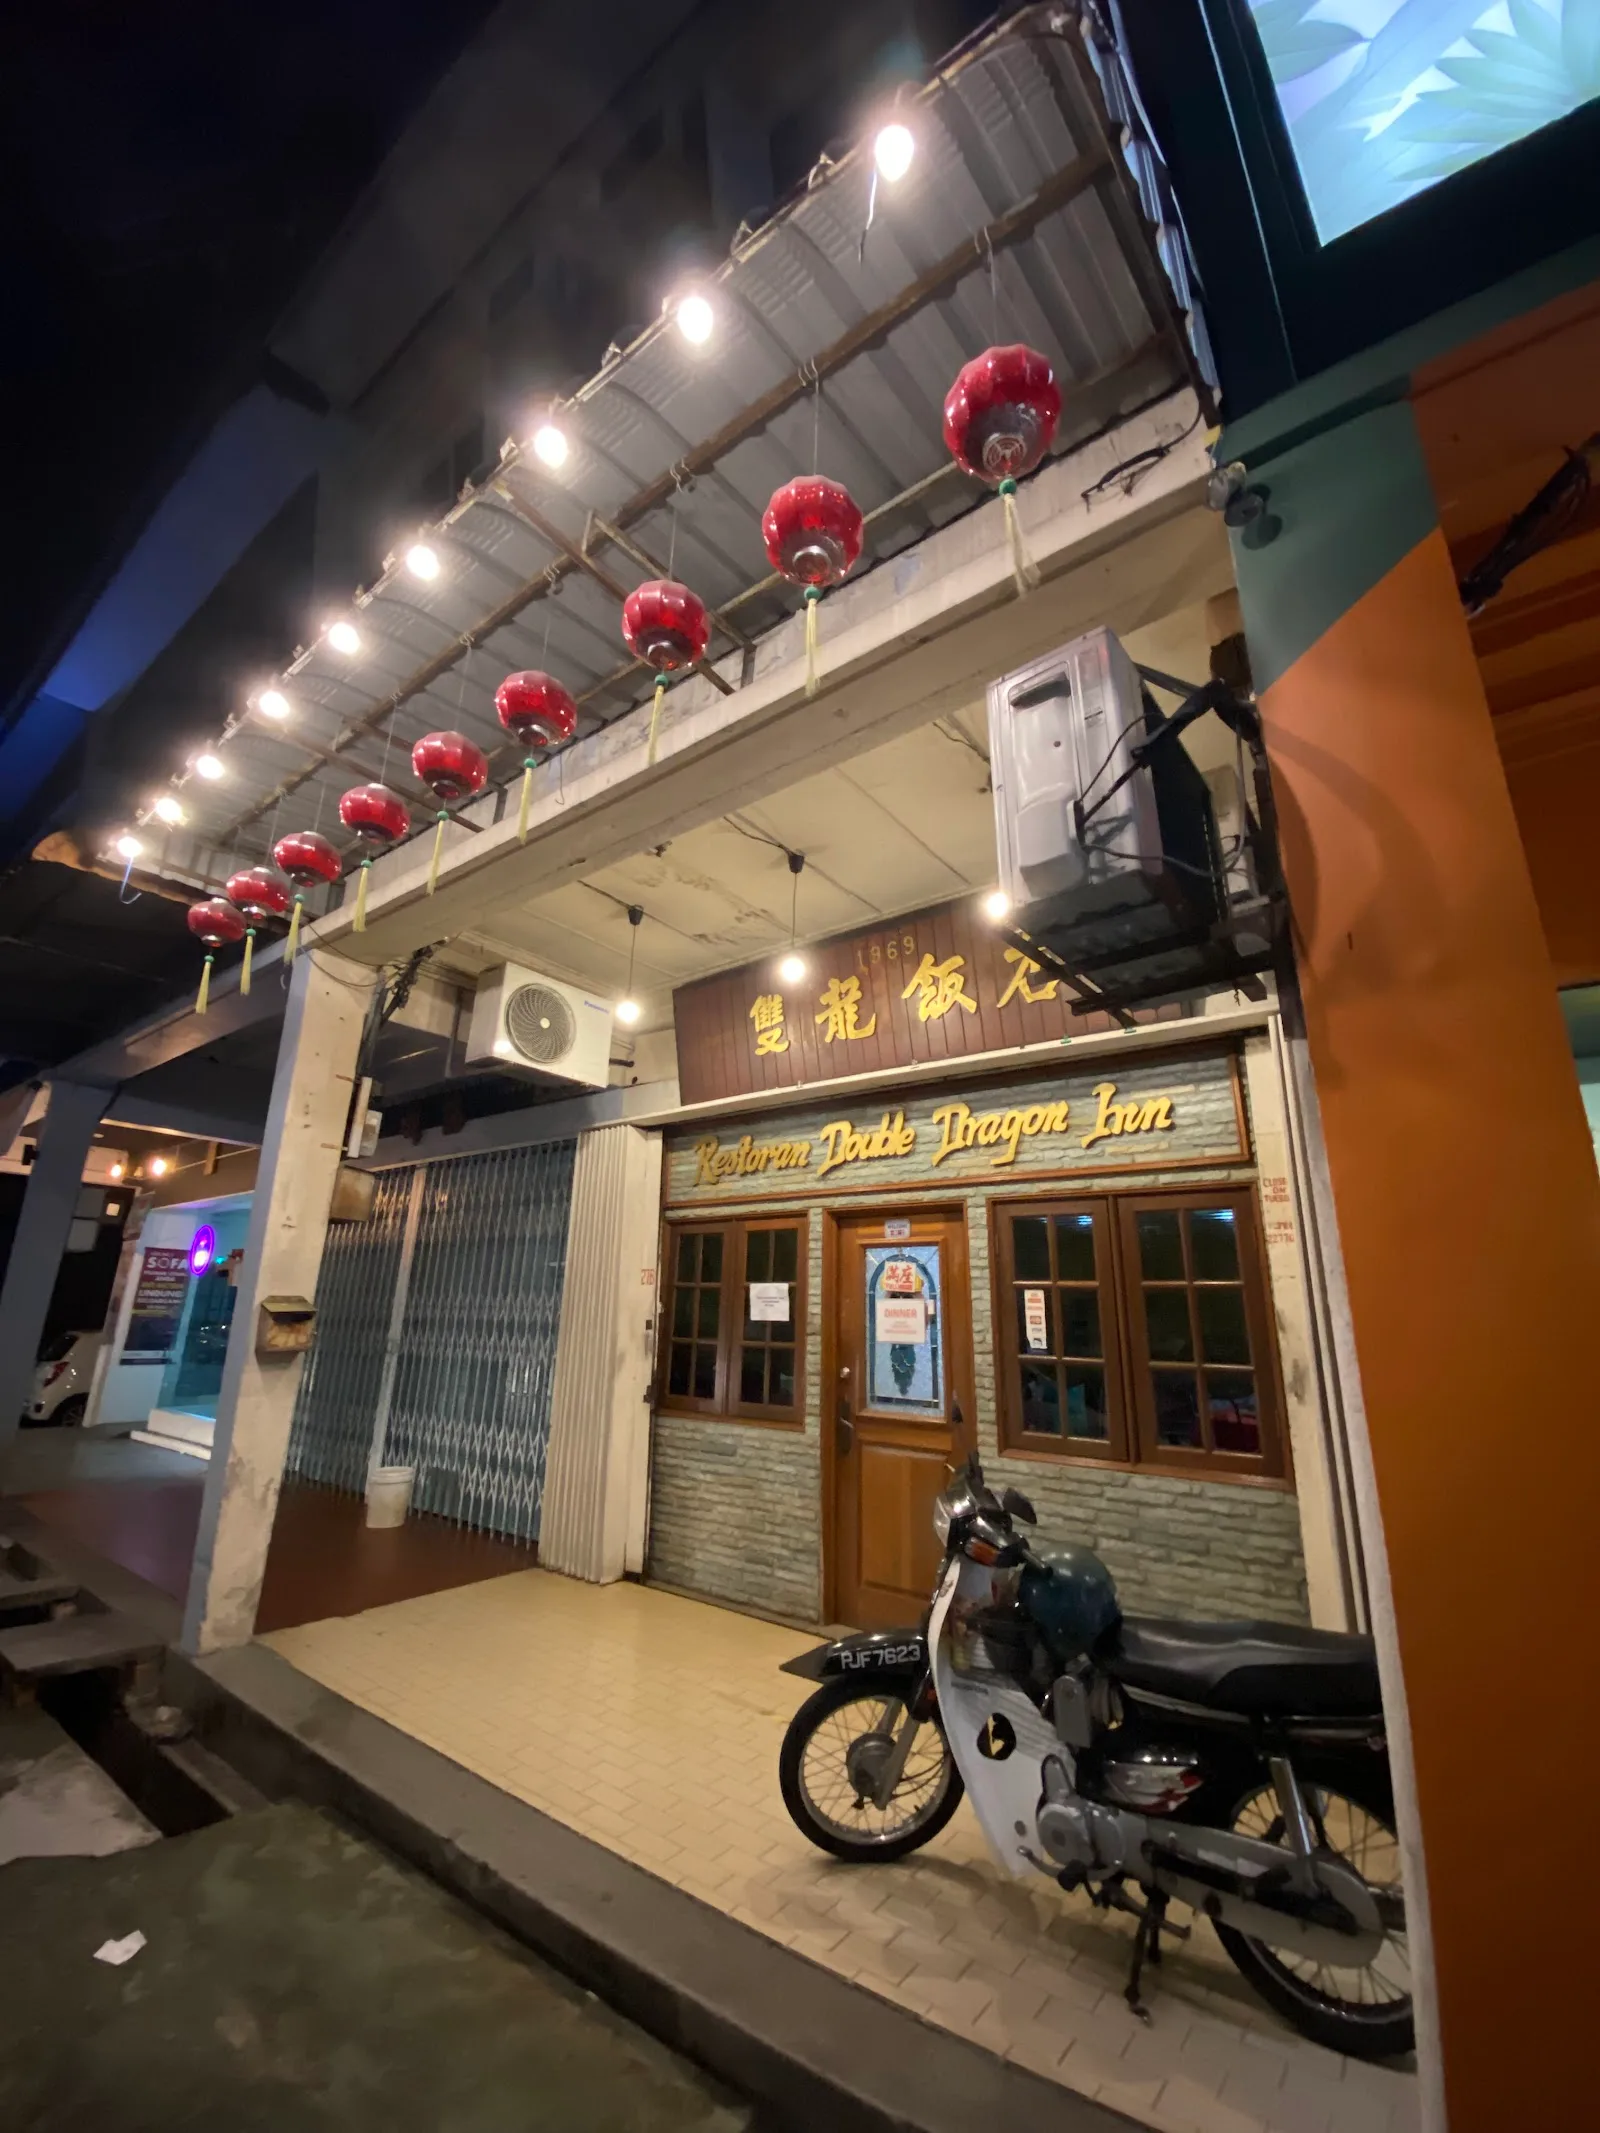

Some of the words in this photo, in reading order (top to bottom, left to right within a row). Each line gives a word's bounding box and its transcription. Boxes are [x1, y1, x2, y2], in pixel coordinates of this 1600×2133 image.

[857, 936, 915, 974] 1969
[693, 1136, 810, 1185] Restoran
[817, 1110, 917, 1175] Double
[931, 1102, 1069, 1166] Dragon
[1081, 1083, 1172, 1148] Inn
